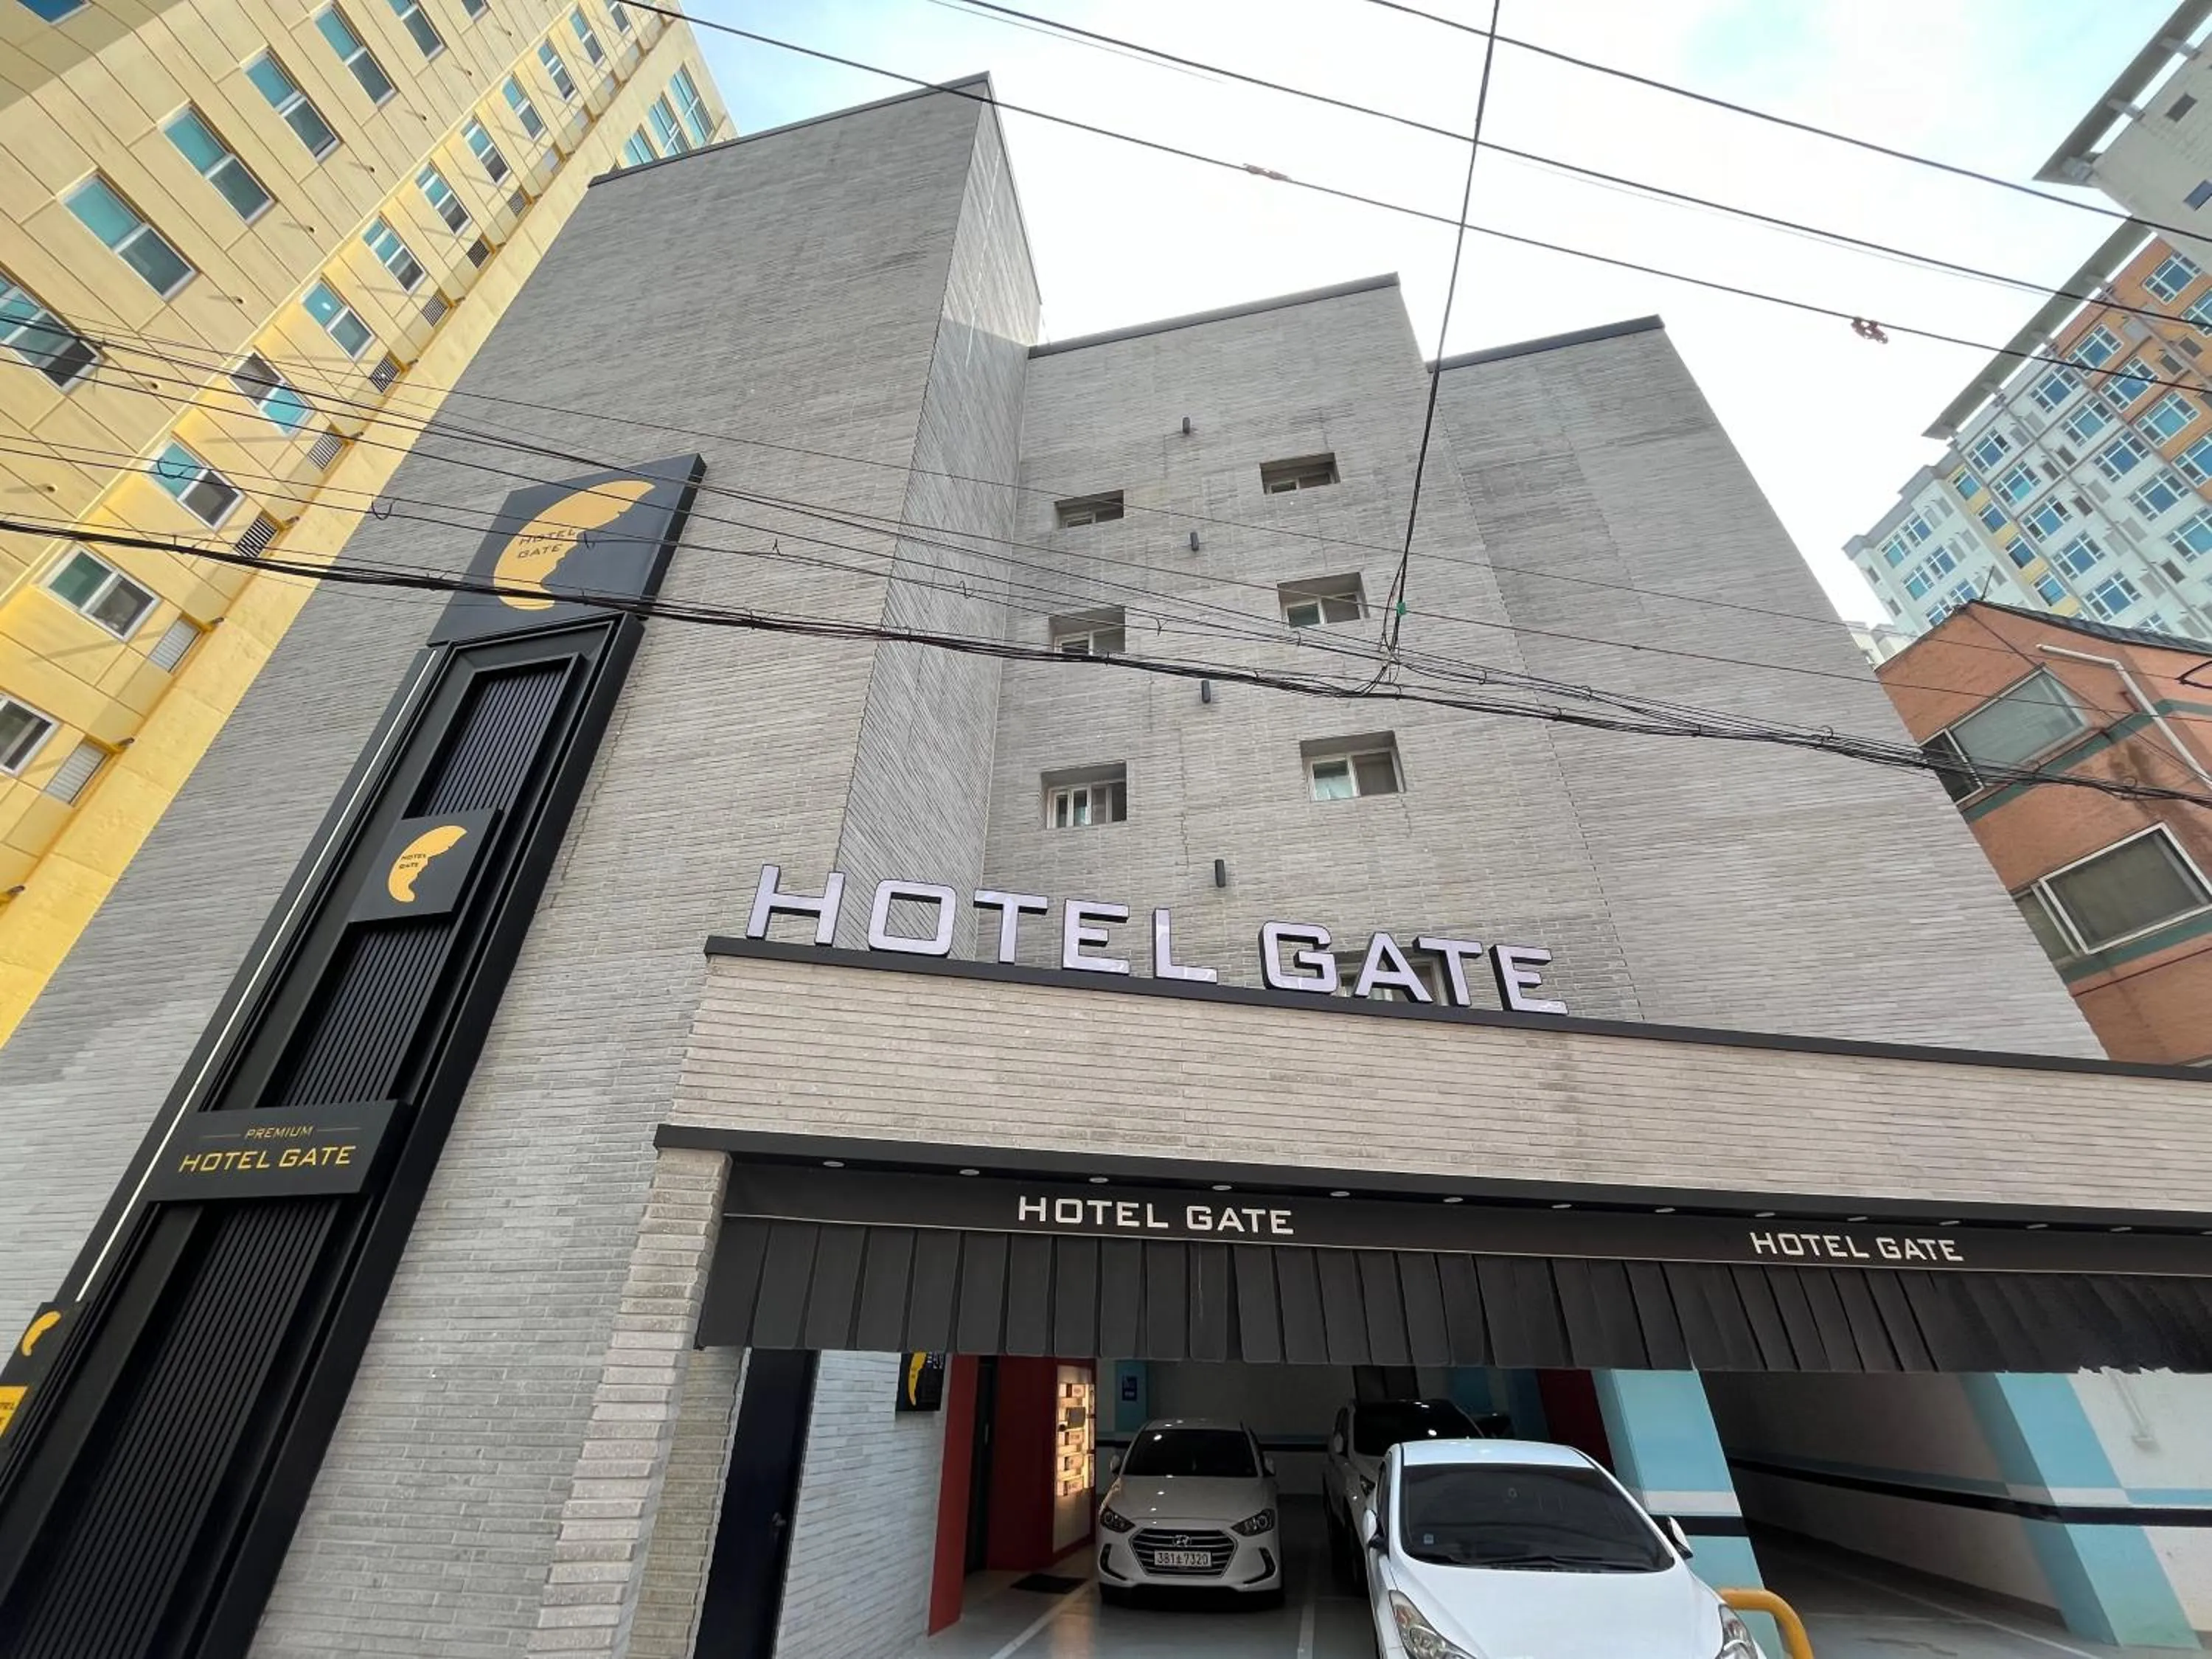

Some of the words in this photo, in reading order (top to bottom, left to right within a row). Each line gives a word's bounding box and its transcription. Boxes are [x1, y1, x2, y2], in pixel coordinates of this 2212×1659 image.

[518, 544, 563, 558] GATE
[745, 863, 1218, 984] HOTEL
[1259, 920, 1568, 1015] GATE
[245, 1126, 313, 1139] PREMIUM
[178, 1150, 271, 1172] HOTEL
[279, 1145, 356, 1168] GATE
[1018, 1195, 1169, 1229] HOTEL
[1186, 1205, 1294, 1234] GATE
[1750, 1232, 1870, 1259] HOTEL
[1876, 1237, 1964, 1262] GATE
